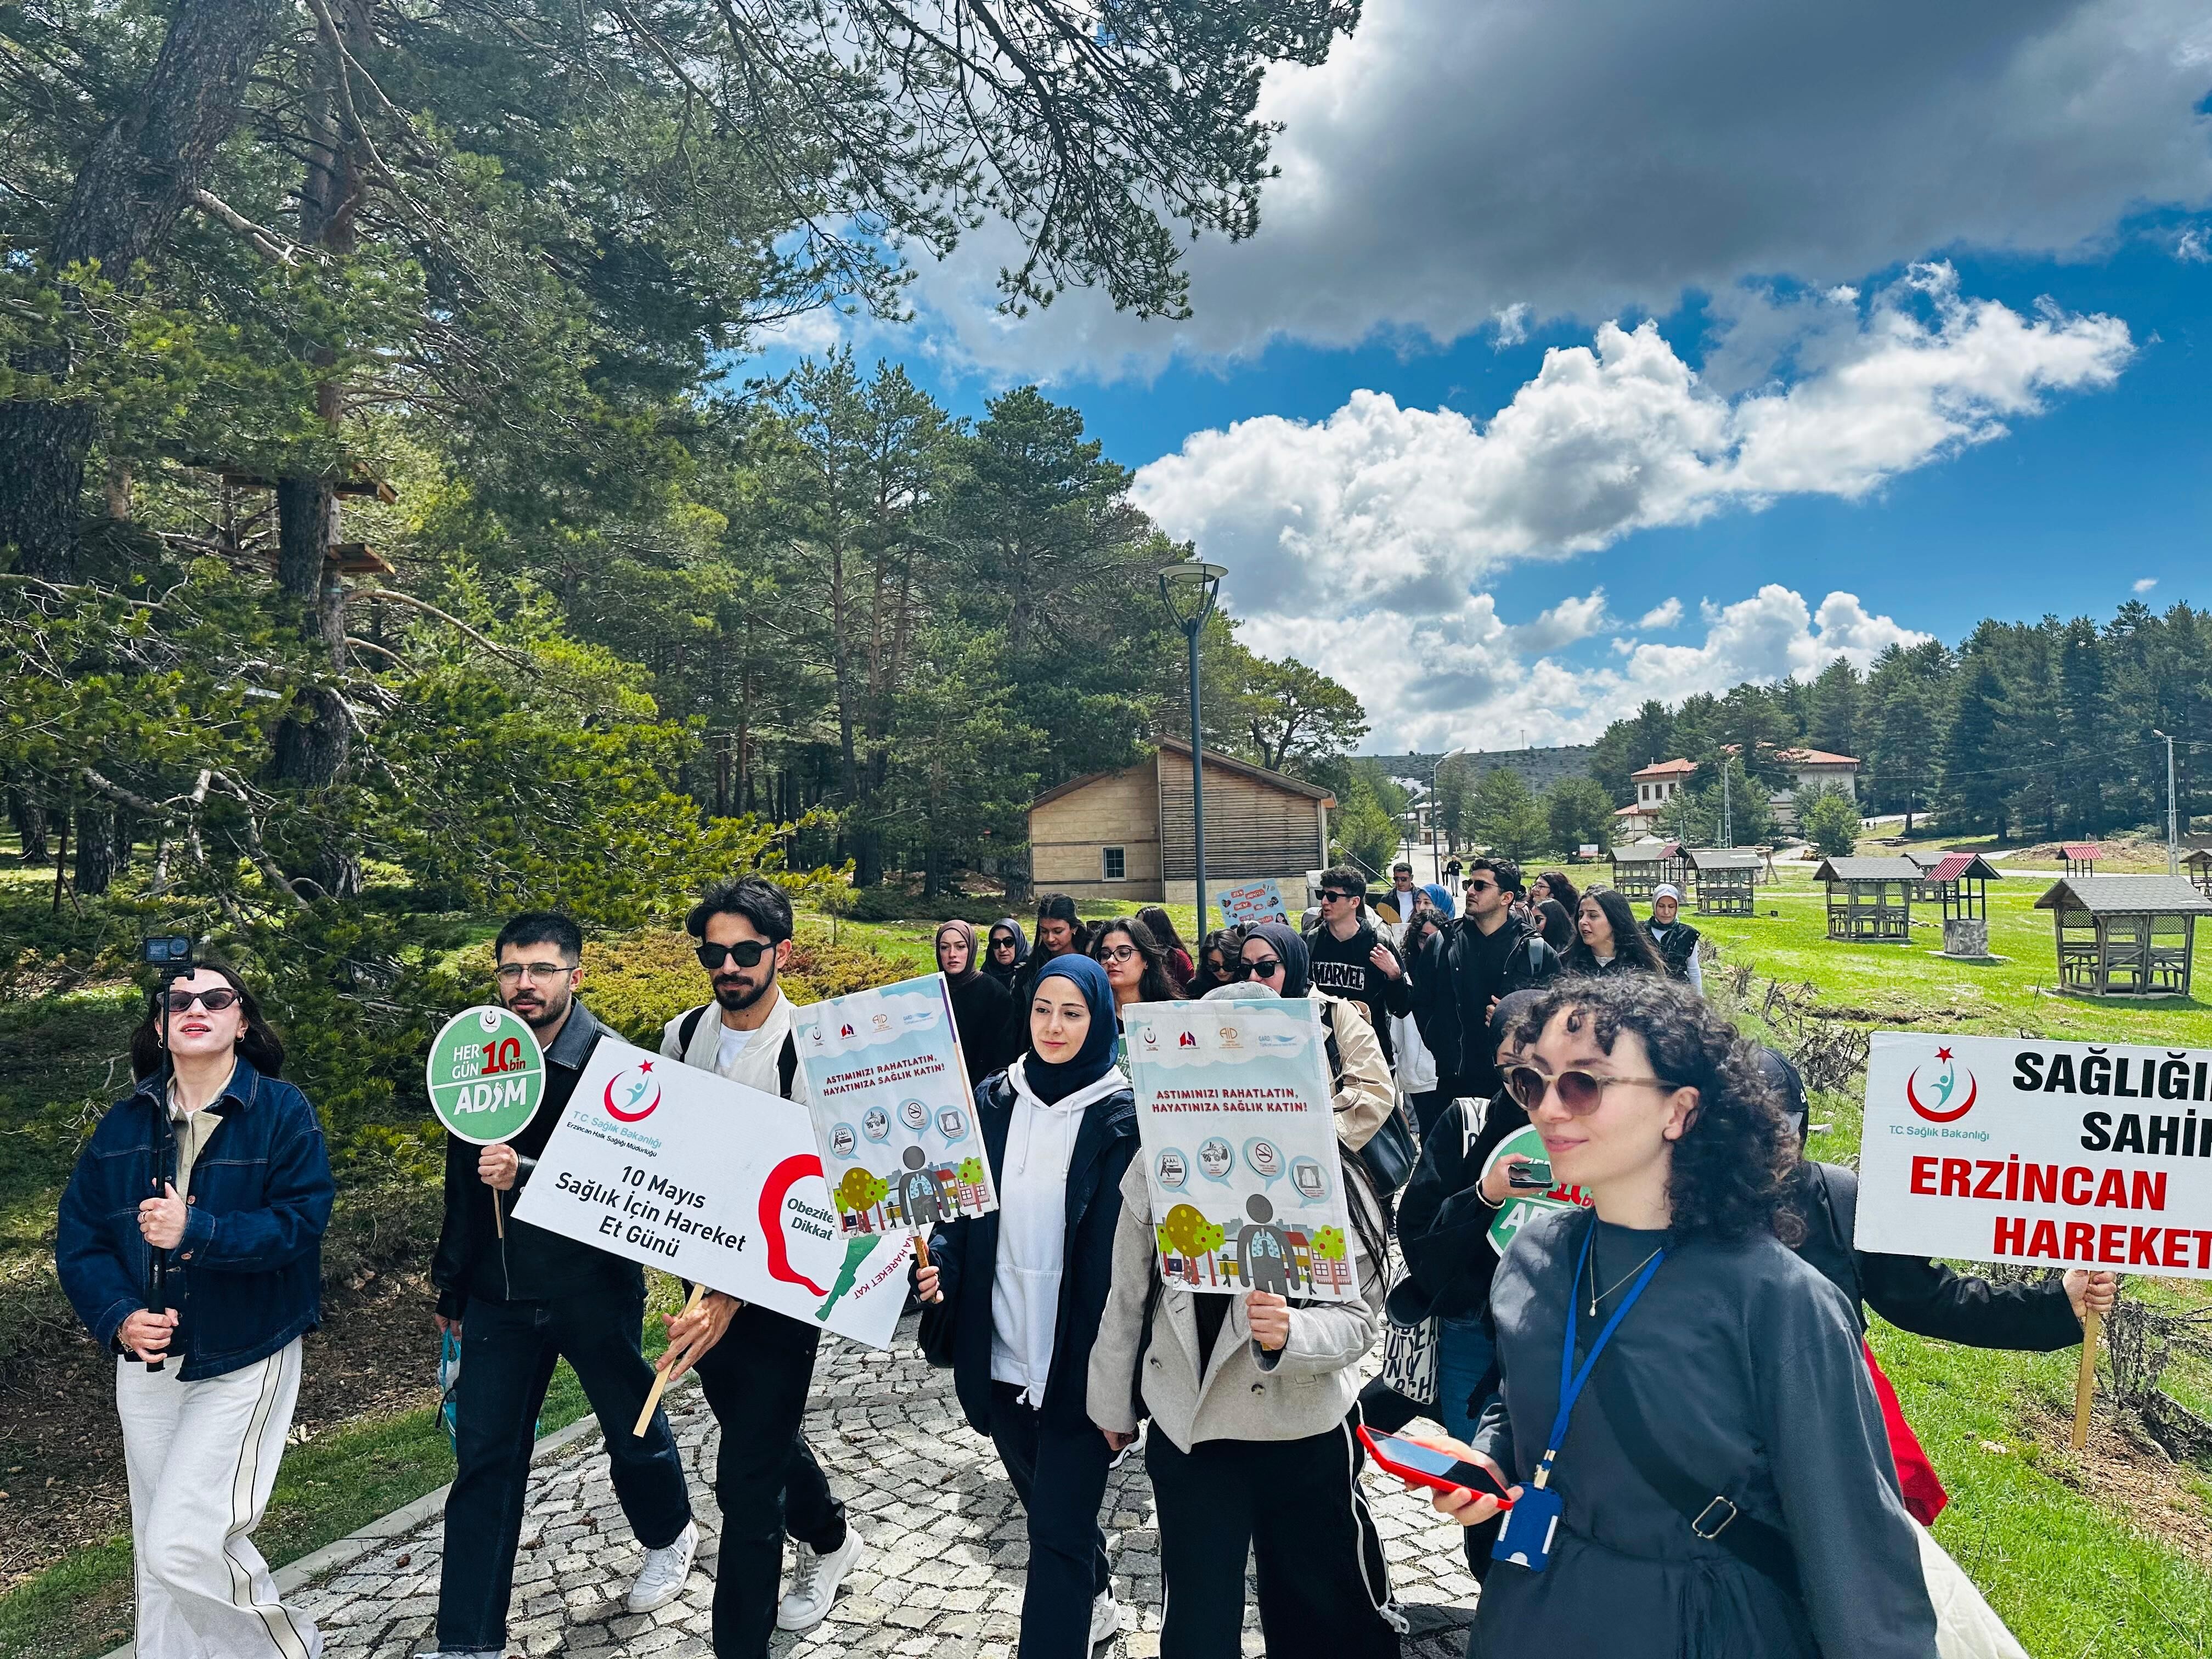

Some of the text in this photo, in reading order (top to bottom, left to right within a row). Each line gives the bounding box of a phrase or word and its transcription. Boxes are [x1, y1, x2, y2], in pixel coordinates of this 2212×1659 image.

[1312, 962, 1364, 989] MARVEL
[452, 1060, 479, 1079] GÜN
[453, 1037, 526, 1075] HER 10 bin
[823, 1063, 945, 1096] HAYATINIZA SAĞLIK KATIN!
[826, 1068, 874, 1085] ASTIMINIZI
[2013, 1047, 2212, 1102] SAĞLIĞI
[1152, 1100, 1308, 1113] HAYATINIZA SAĞLIK KATIN!
[1156, 1088, 1299, 1099] ASTIMINIZI RAHATLATIN,
[567, 1121, 592, 1135] Erzincan
[592, 1130, 606, 1139] Halk
[606, 1135, 626, 1148] Sağlığı
[591, 1118, 619, 1133] Sağlık
[620, 1127, 662, 1149] Bakanlığı
[1906, 1126, 1939, 1138] Sağlık
[1942, 1128, 1990, 1142] Bakanlığı
[622, 1165, 706, 1209] 10 Mayıs
[1910, 1153, 2168, 1211] ERZİNCAN
[555, 1172, 747, 1252] Sağlık İçin Hareket
[787, 1198, 834, 1227] Obezite
[599, 1215, 680, 1257] Et Günü
[791, 1216, 833, 1240] Dikkat
[1993, 1216, 2212, 1269] HAREKET
[871, 1249, 907, 1287] HAREKET
[854, 1283, 870, 1300] KAT
